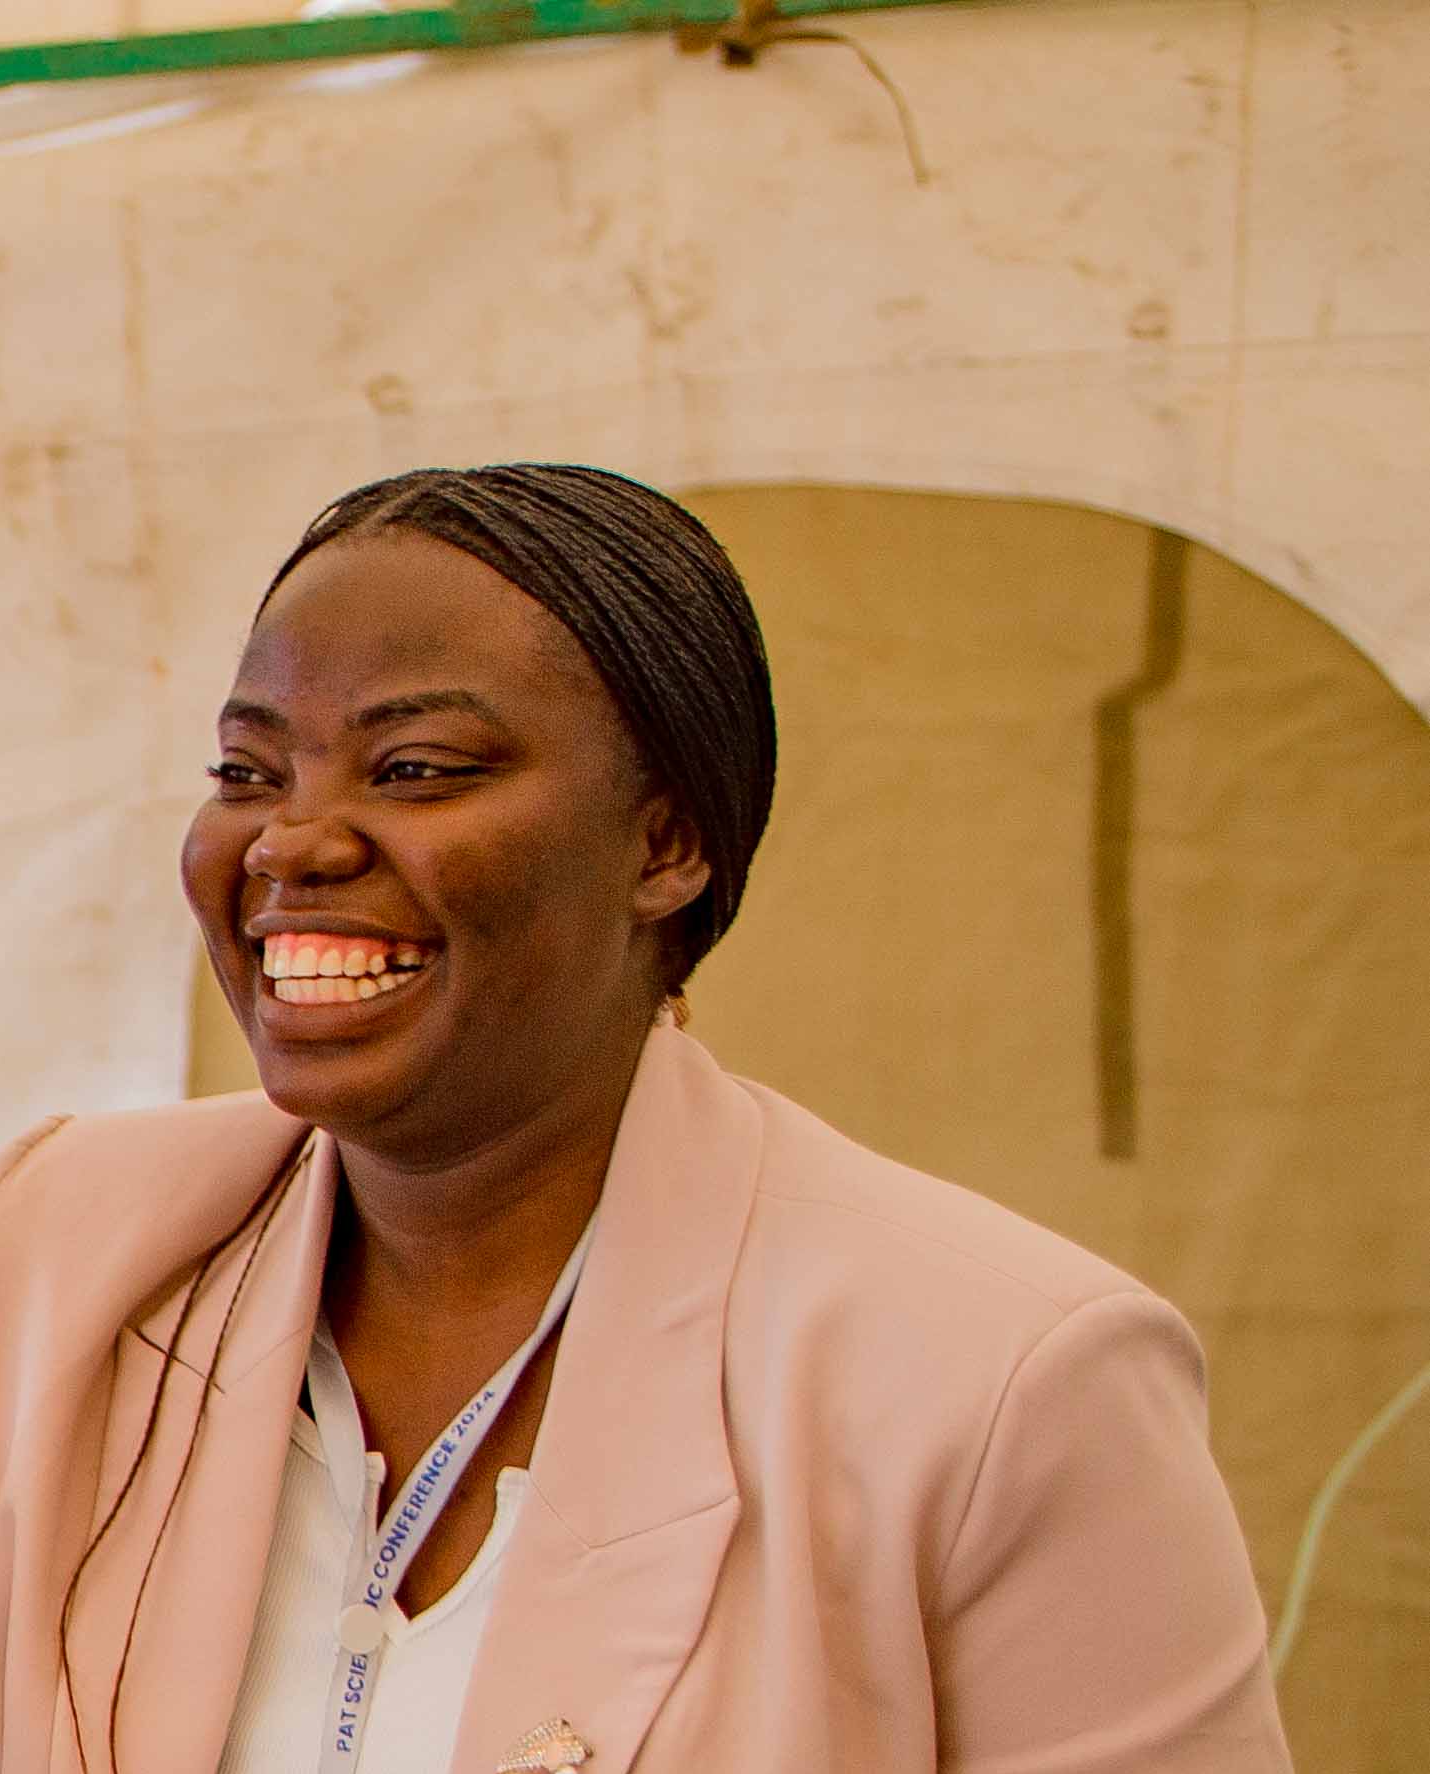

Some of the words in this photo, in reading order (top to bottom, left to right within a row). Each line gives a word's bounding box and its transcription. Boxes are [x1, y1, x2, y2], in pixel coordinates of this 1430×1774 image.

[336, 1708, 361, 1754] PAT
[369, 1435, 460, 1580] CONFERENCE
[453, 1389, 496, 1438] 2024
